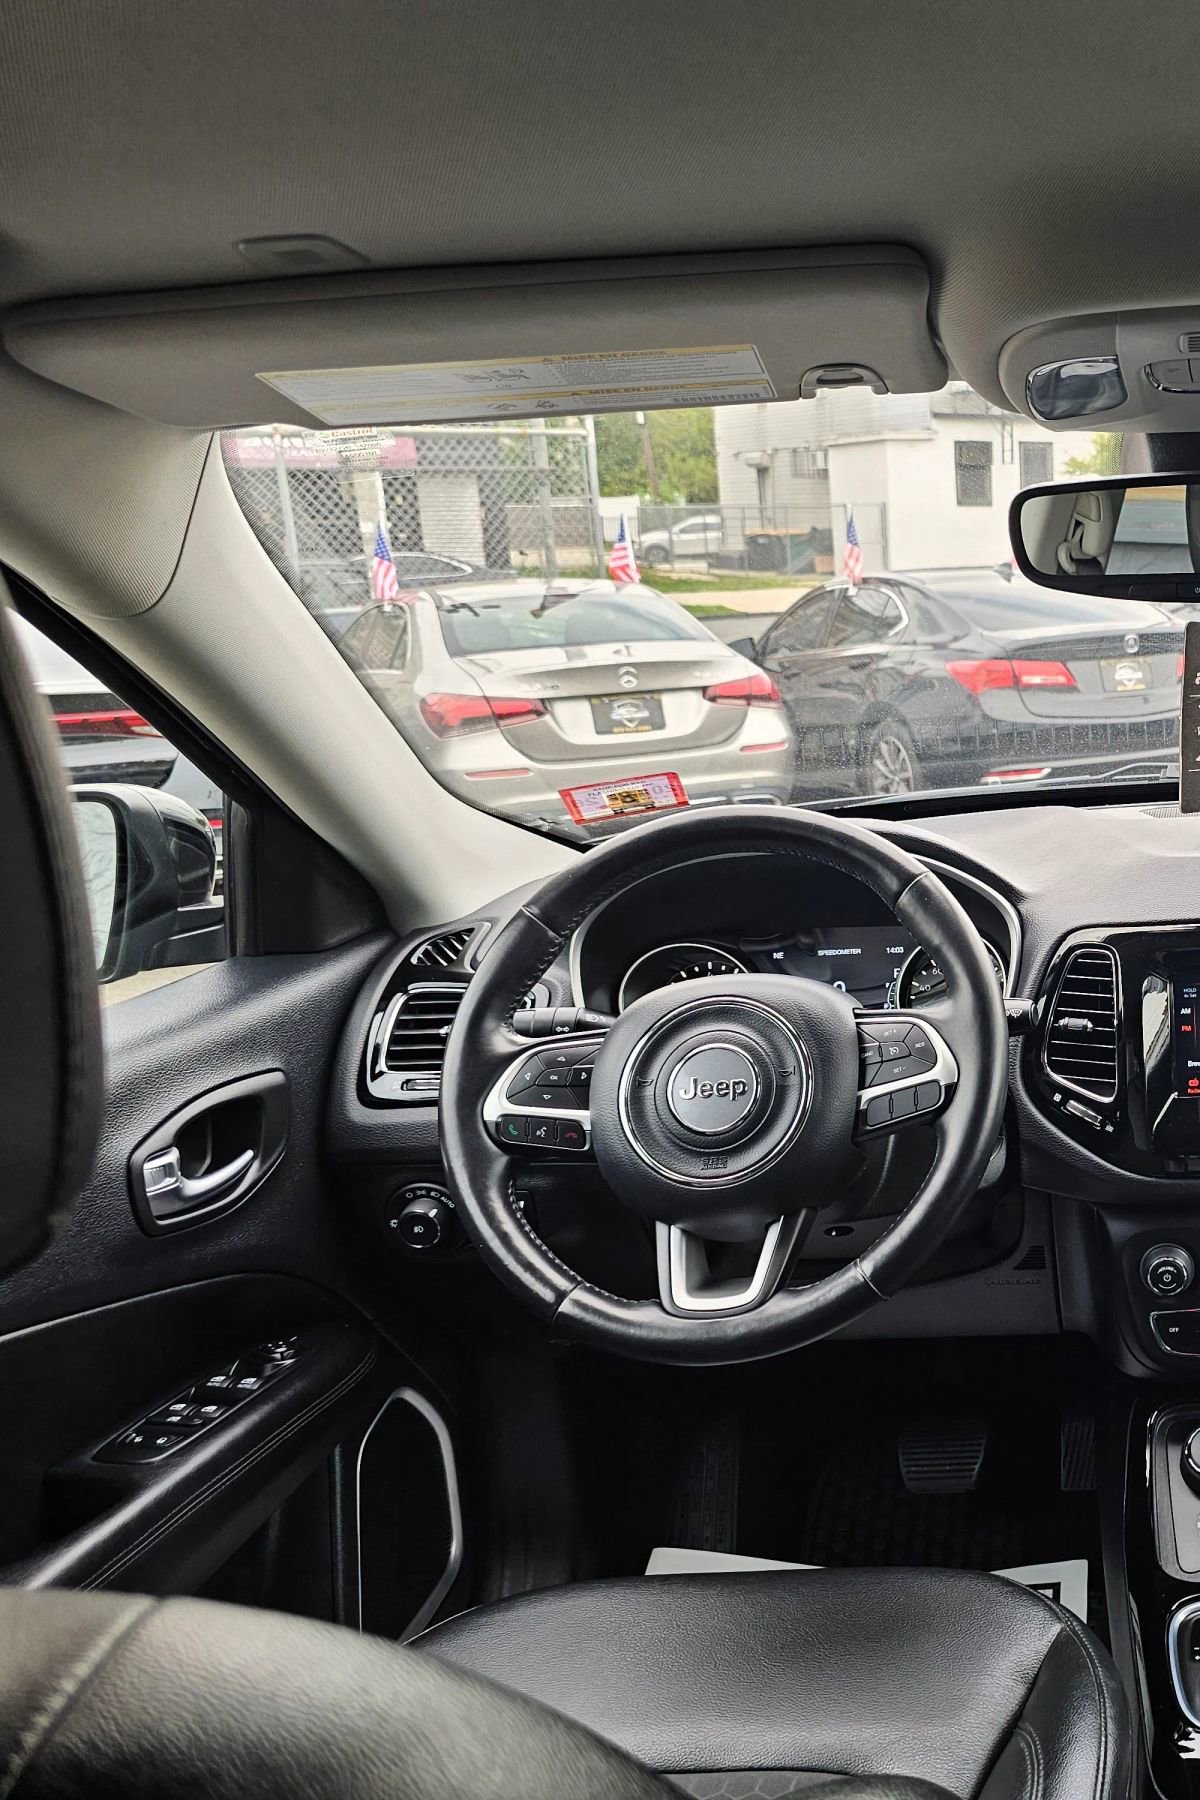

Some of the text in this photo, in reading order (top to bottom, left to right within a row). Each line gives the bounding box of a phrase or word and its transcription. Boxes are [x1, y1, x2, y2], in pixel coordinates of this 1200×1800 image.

[817, 947, 862, 956] SPEEDOMETER
[886, 946, 905, 954] 14:03
[772, 951, 785, 960] NE
[919, 984, 931, 992] 40
[1180, 1007, 1191, 1015] AM
[678, 1076, 748, 1101] Jeep
[440, 1196, 456, 1209] AUTO
